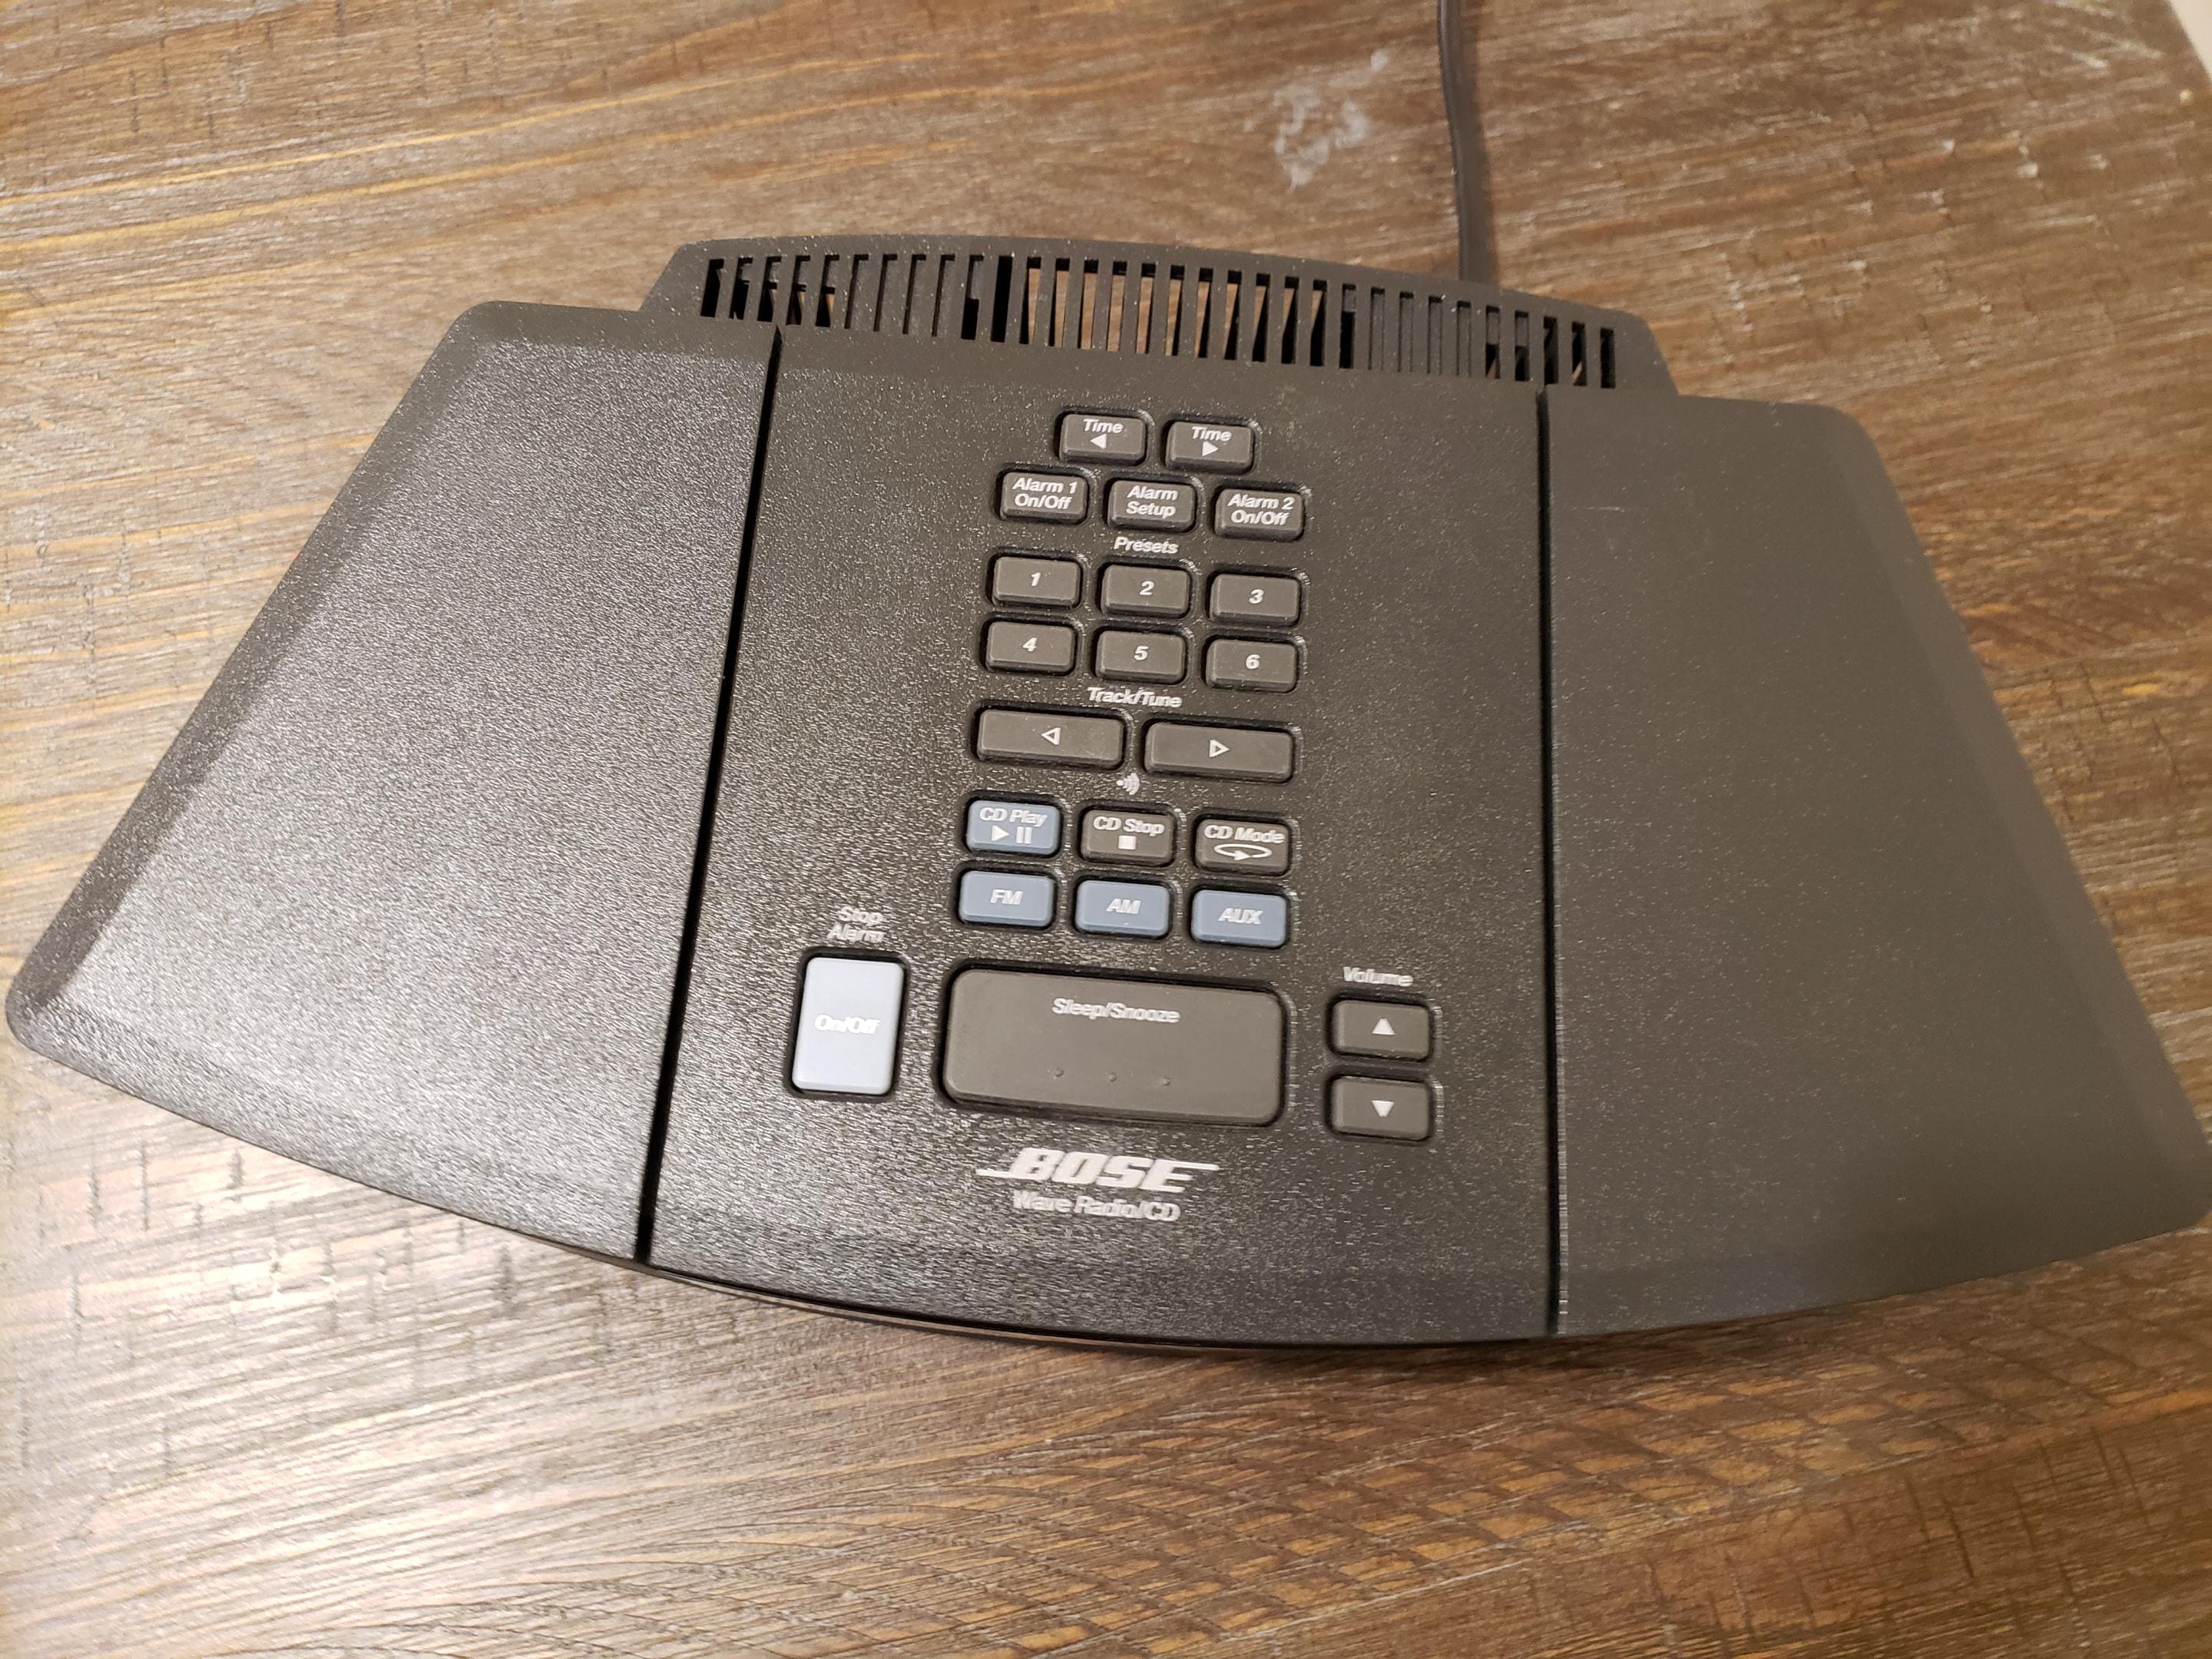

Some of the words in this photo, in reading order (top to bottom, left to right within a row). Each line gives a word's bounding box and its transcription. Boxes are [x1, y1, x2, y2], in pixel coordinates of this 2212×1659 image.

[1083, 419, 1123, 434] Time
[1191, 426, 1232, 442] Time
[1012, 477, 1062, 493] Alarm
[1068, 481, 1078, 494] 1
[1127, 485, 1177, 501] Alarm
[1015, 493, 1072, 510] On/Off
[1126, 501, 1176, 518] Setup
[1227, 494, 1277, 509] Alarm
[1281, 497, 1294, 510] 2
[1231, 510, 1290, 525] On/Off
[1114, 537, 1178, 554] Presets
[1030, 573, 1041, 586] 1
[1139, 581, 1154, 595] 2
[1249, 590, 1264, 604] 3
[1022, 638, 1037, 651] 4
[1134, 646, 1149, 661] 5
[1245, 654, 1260, 669] 6
[1088, 687, 1182, 708] Track/Tune
[979, 807, 1007, 822] CD
[1009, 809, 1048, 827] Play
[1093, 816, 1117, 831] CD
[1118, 819, 1165, 836] Stop
[1204, 825, 1233, 840] CD
[1235, 827, 1284, 843] Mode
[990, 889, 1023, 906] FM
[839, 906, 884, 925] Stop
[1106, 899, 1141, 915] AM
[1218, 908, 1263, 925] AUX
[828, 925, 884, 944] Alarm
[1343, 966, 1413, 987] Volume
[1052, 998, 1180, 1024] Sleep/Snooze
[815, 1015, 881, 1035] On/Off
[977, 1148, 1219, 1193] BOSE
[1012, 1190, 1073, 1214] Wave
[1076, 1195, 1181, 1222] Radio/CD
